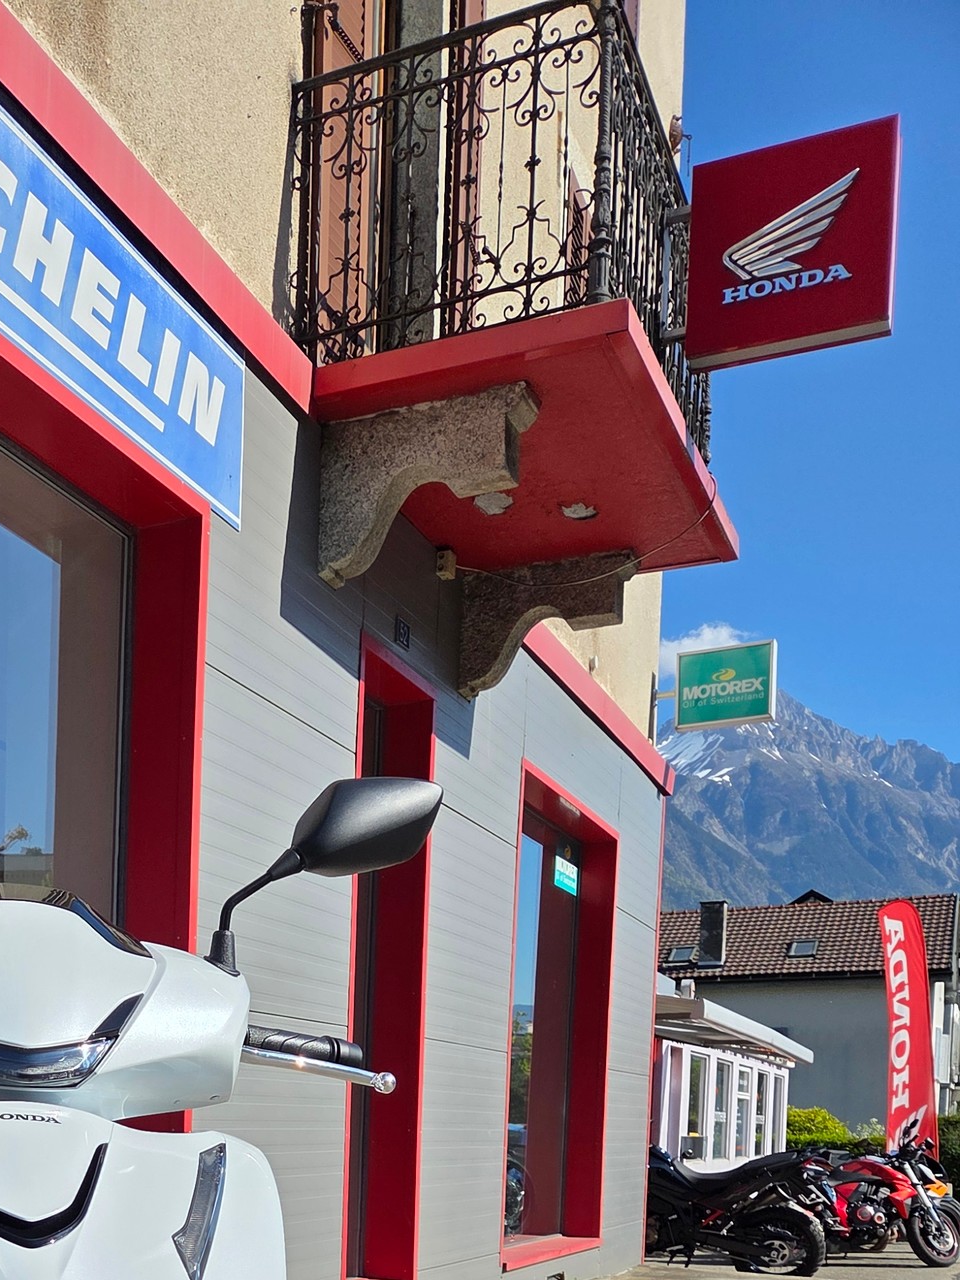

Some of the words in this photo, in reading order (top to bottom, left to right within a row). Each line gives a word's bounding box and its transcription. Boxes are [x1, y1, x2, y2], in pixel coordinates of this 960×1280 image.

[722, 264, 852, 304] HONDA
[683, 678, 764, 700] MOTOREX
[682, 700, 695, 709] Oil
[698, 698, 708, 707] of
[710, 692, 764, 705] Switzerland
